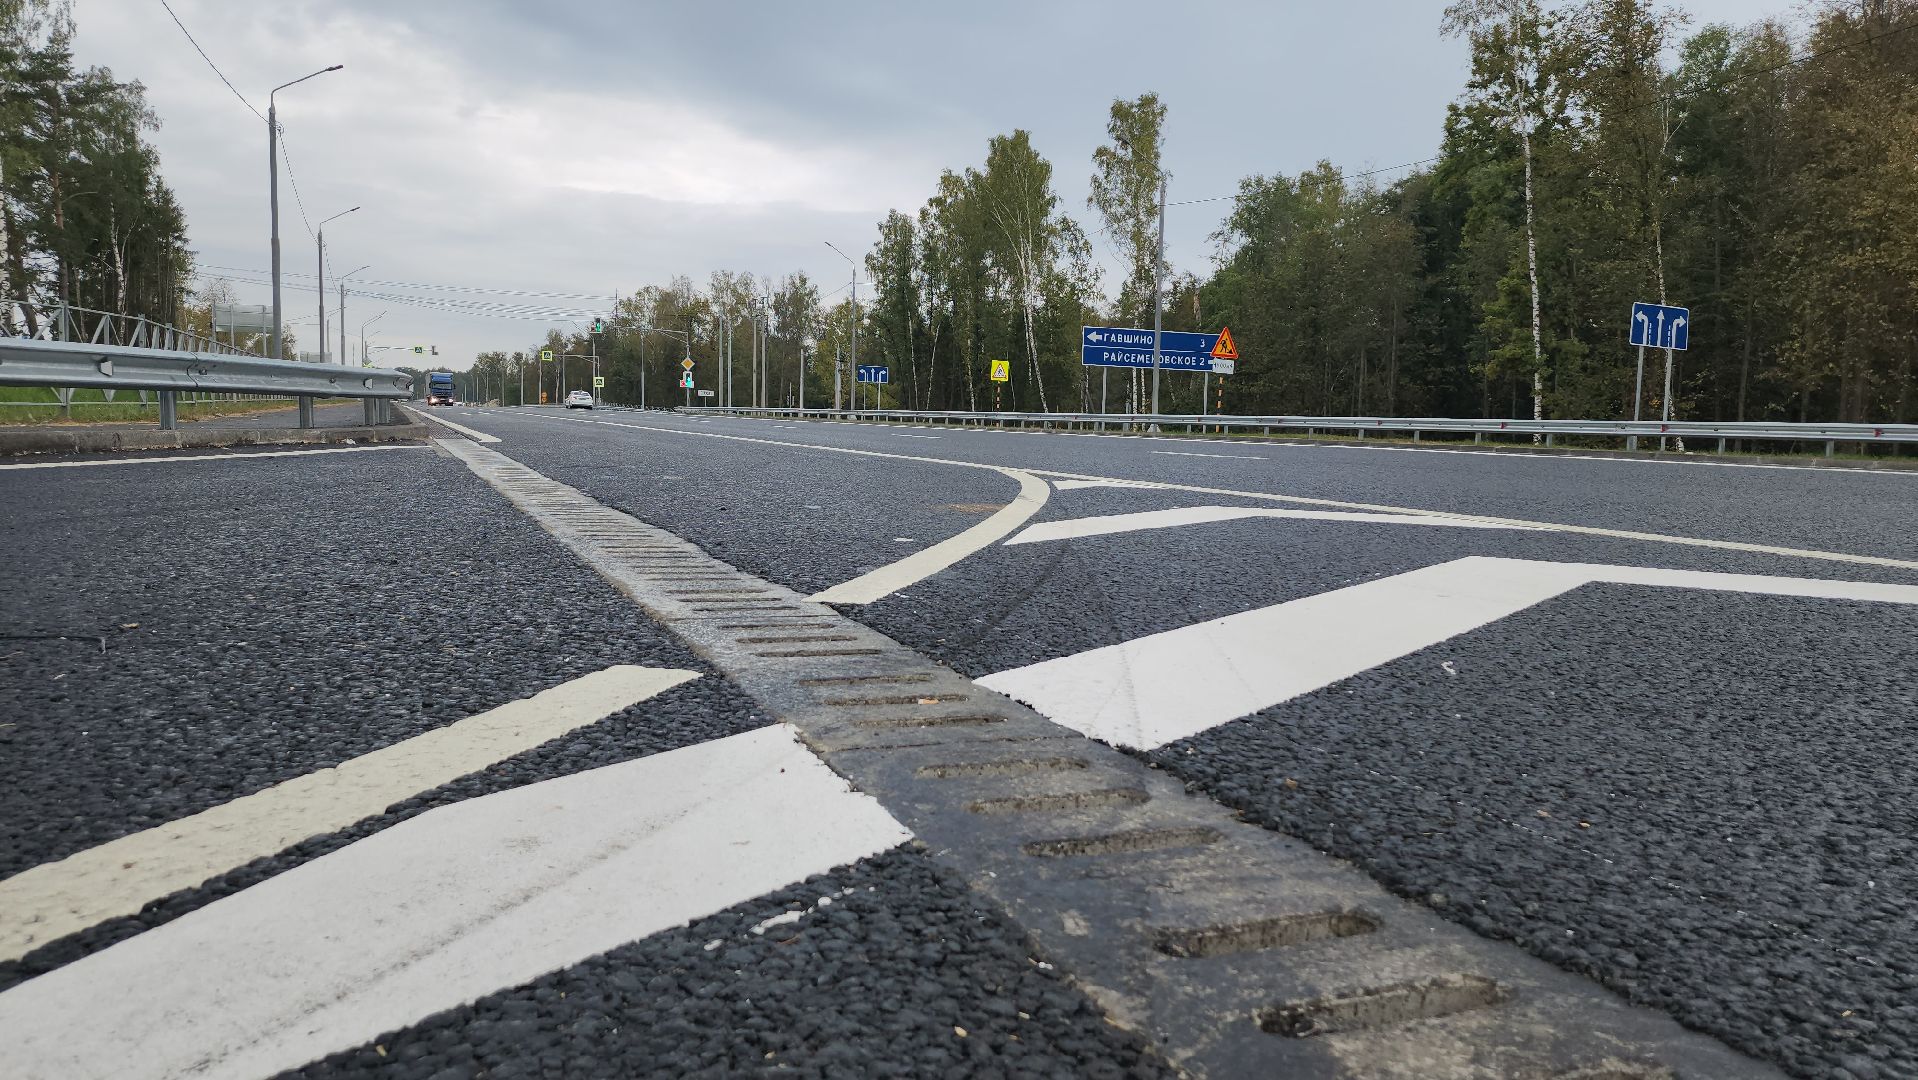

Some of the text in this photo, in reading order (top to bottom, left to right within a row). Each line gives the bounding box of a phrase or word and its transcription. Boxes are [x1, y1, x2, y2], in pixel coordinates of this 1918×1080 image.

[1103, 333, 1206, 348] ГАВШИНО 3
[1199, 357, 1205, 366] 2
